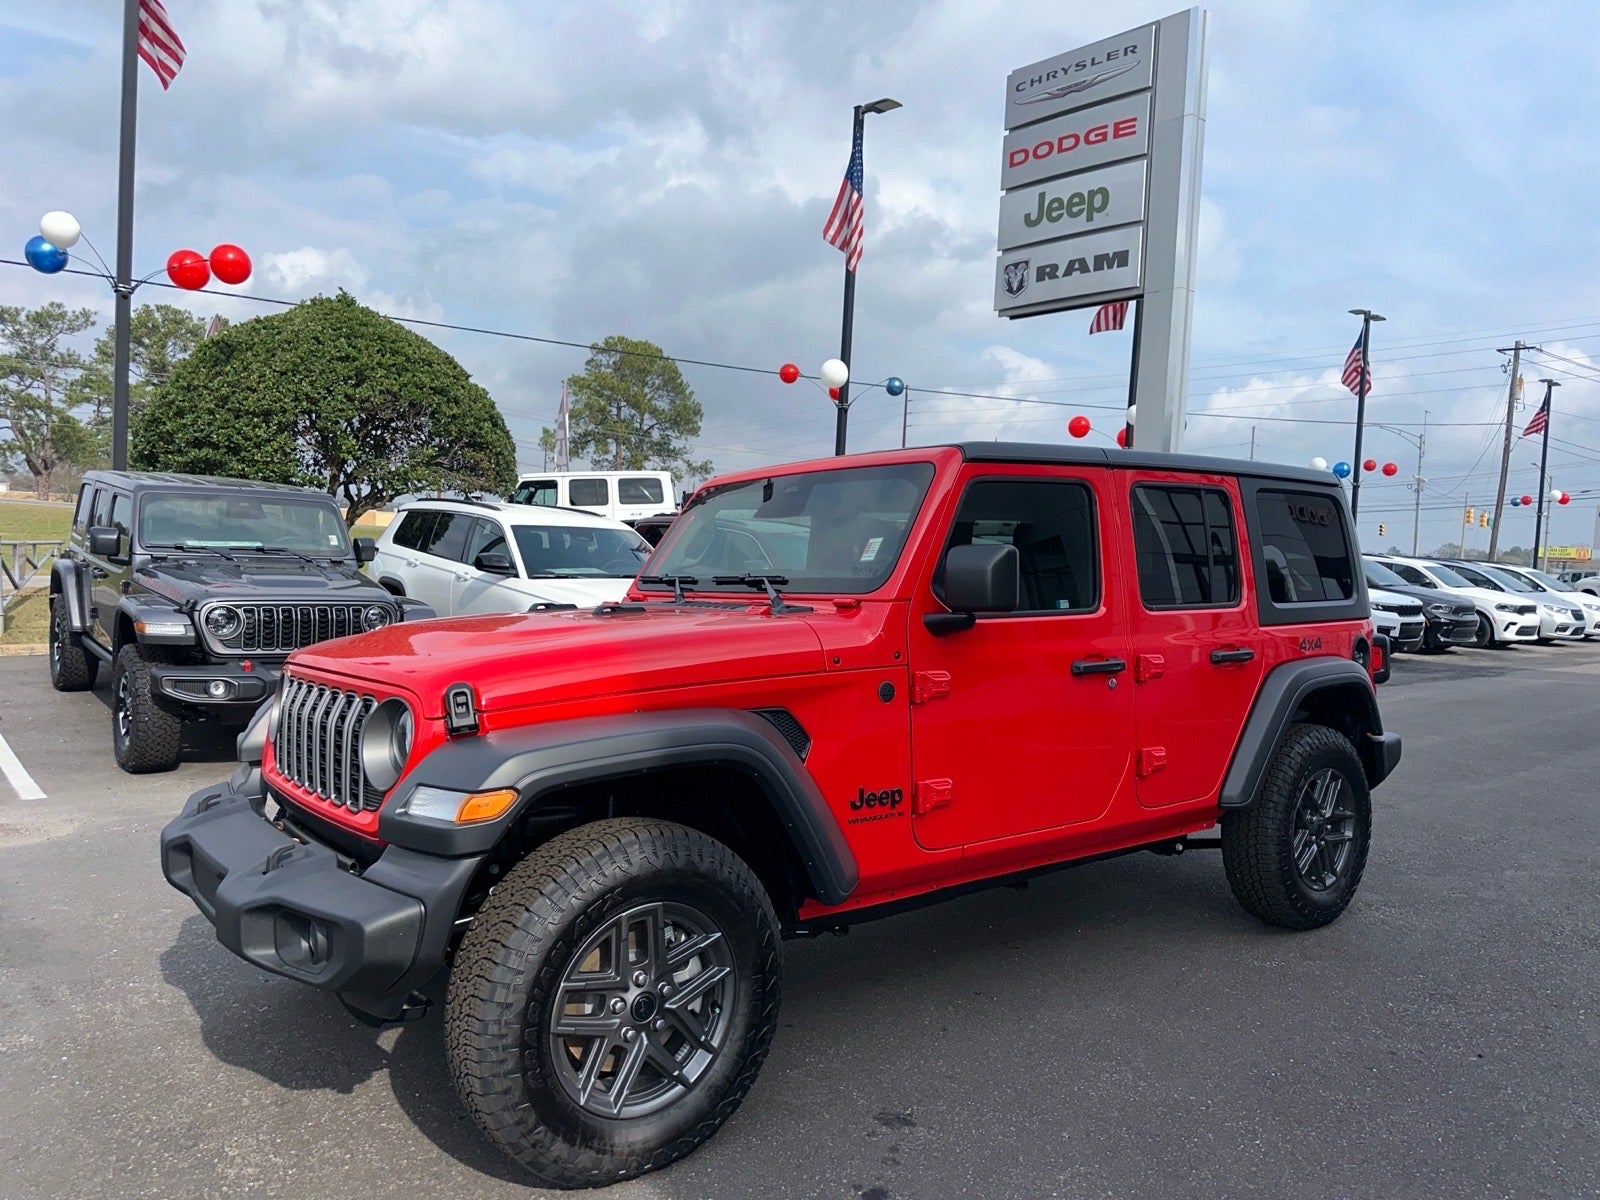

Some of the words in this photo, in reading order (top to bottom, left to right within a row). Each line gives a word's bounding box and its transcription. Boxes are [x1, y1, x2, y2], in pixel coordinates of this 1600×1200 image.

[1015, 44, 1139, 93] CHRYSLER
[1008, 117, 1138, 169] DODGE
[1023, 186, 1110, 229] Jeep
[1035, 249, 1130, 283] RAM
[1299, 637, 1322, 651] 4x4
[850, 787, 903, 810] Jeep
[848, 812, 897, 824] WRANGLER
